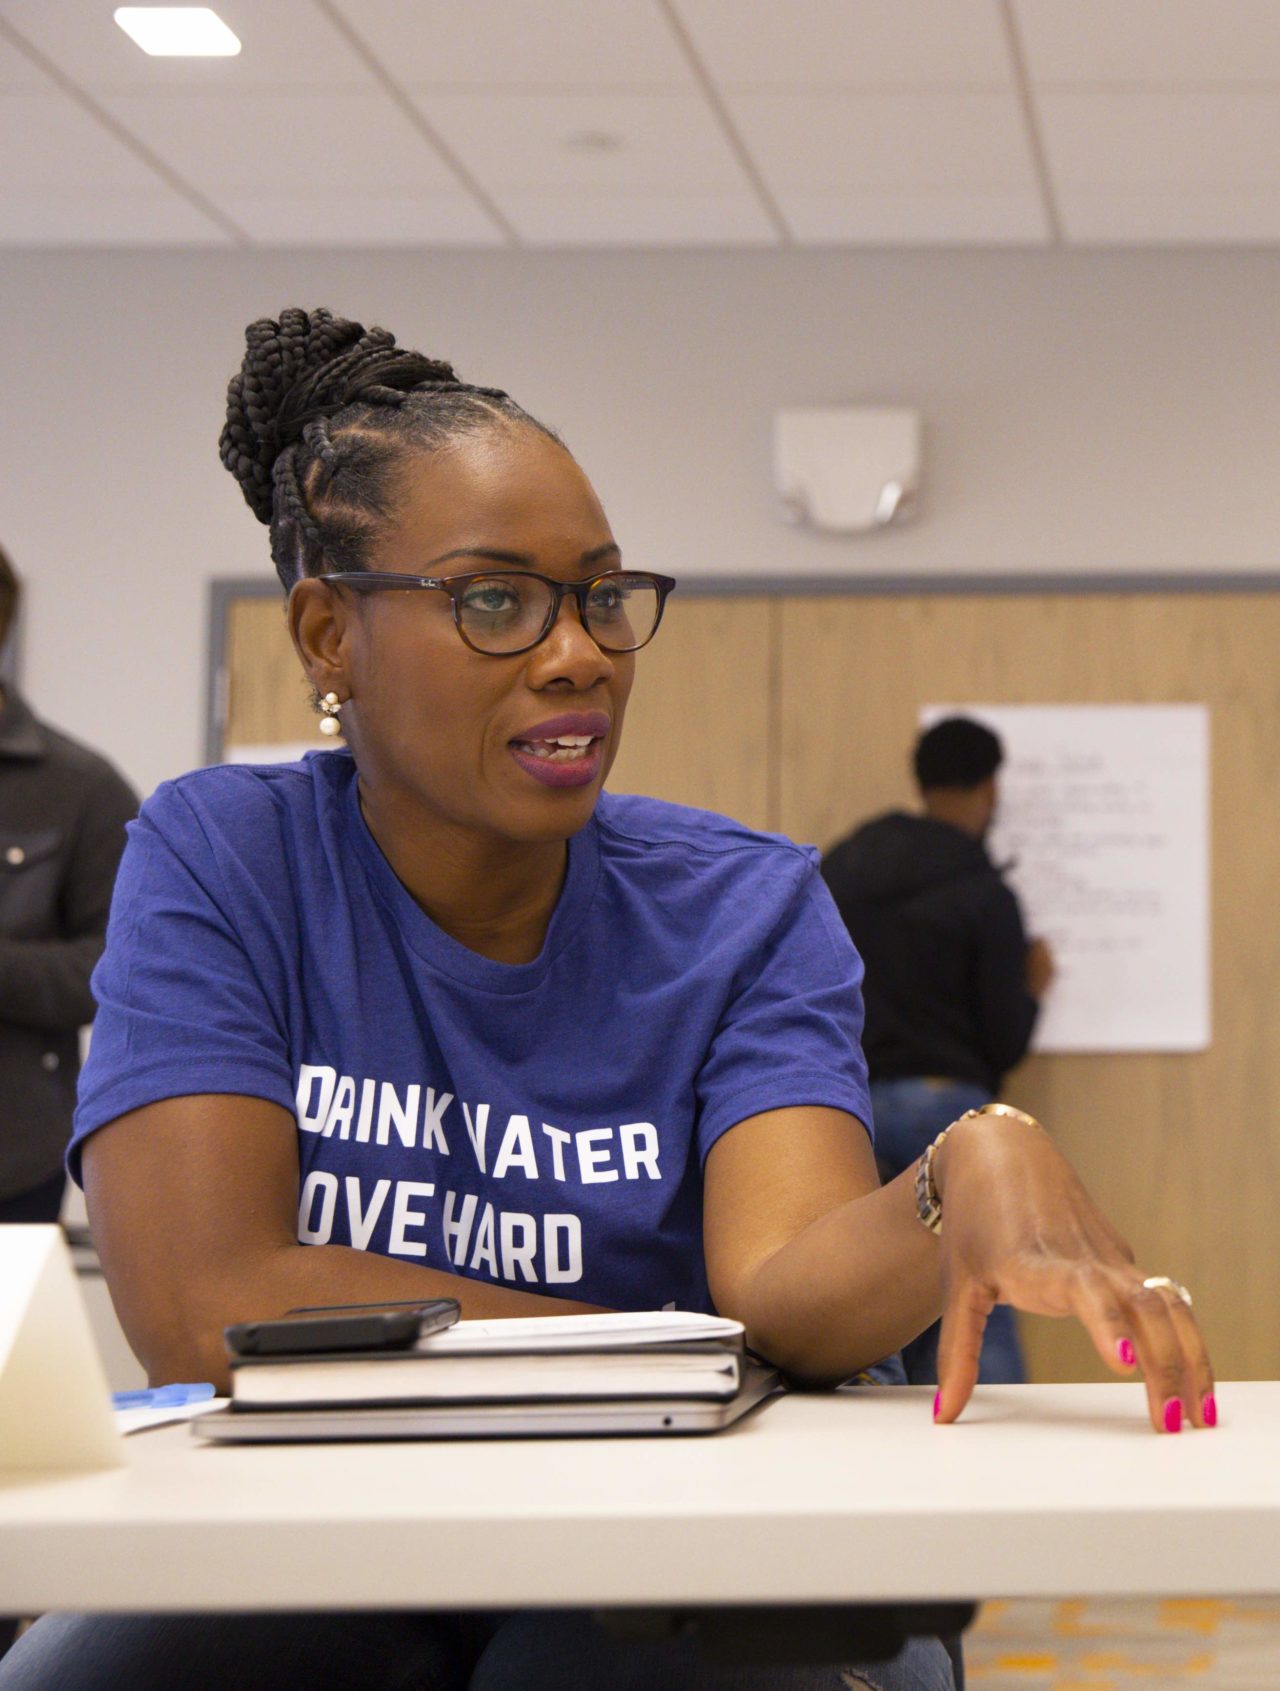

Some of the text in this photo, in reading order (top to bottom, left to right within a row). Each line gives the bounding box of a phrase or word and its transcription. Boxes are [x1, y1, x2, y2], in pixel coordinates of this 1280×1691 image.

[296, 1064, 454, 1155] DRINK
[297, 1171, 583, 1284] OVE HARD
